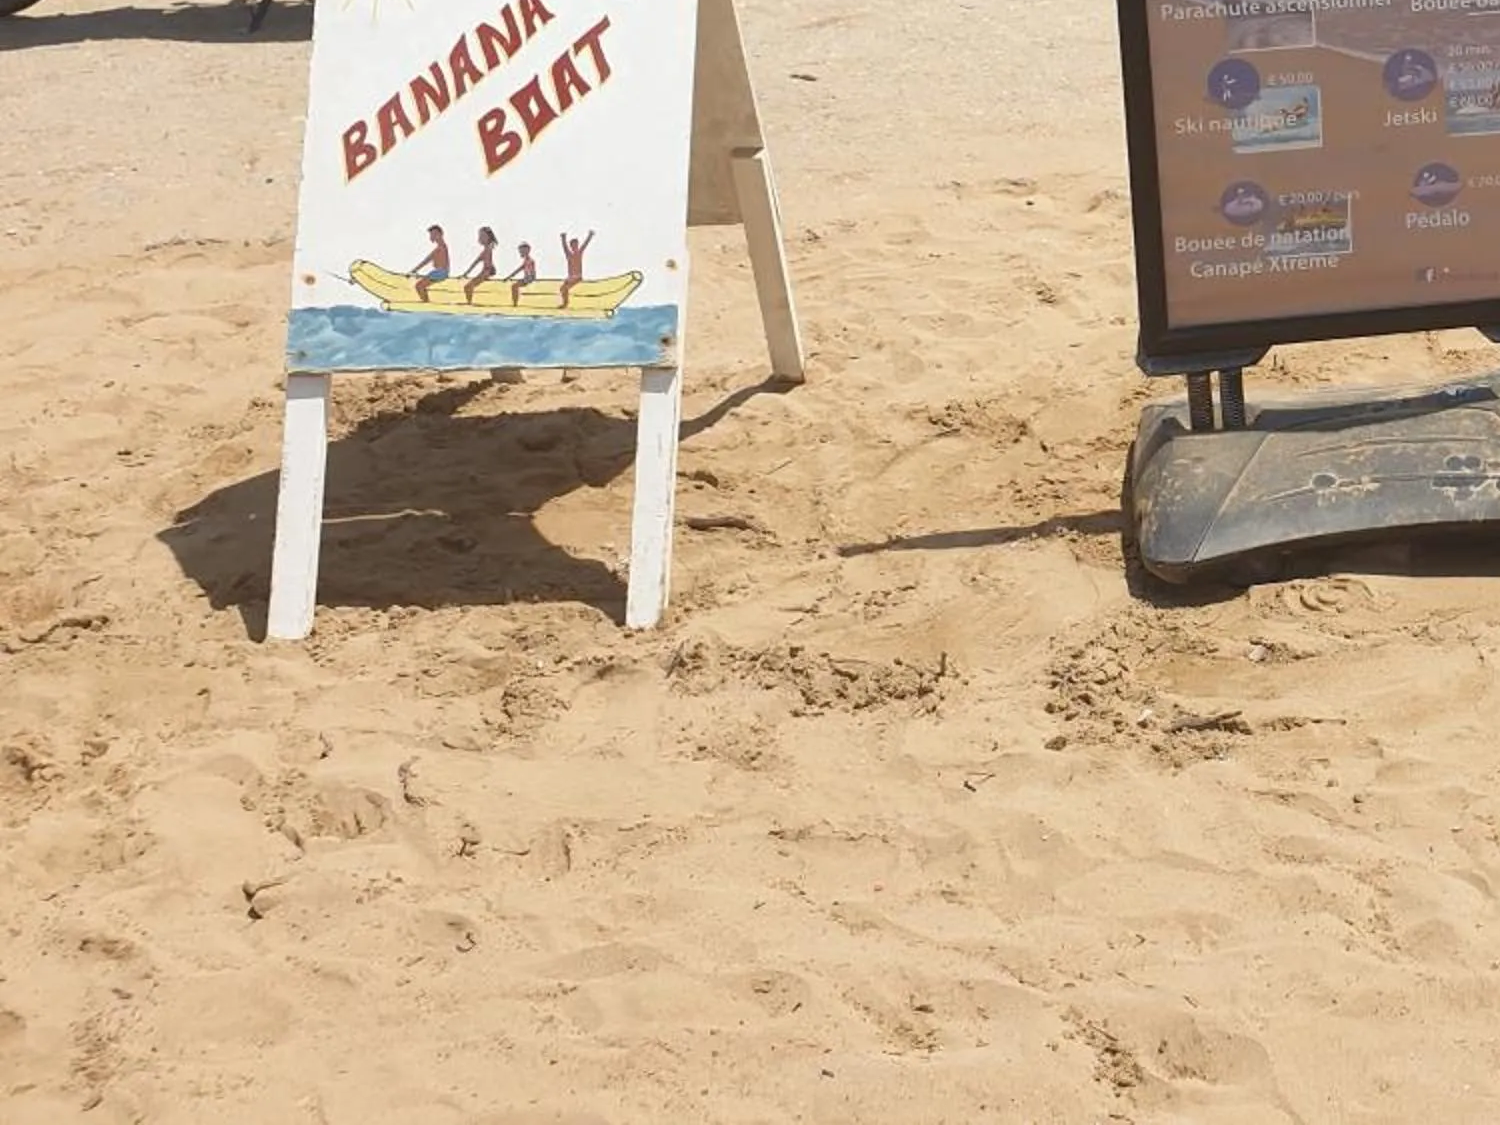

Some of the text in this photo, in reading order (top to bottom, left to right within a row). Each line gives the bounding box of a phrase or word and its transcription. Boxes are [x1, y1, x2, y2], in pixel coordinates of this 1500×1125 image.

[477, 15, 611, 176] BOAT
[1174, 115, 1203, 136] Ski
[1384, 107, 1438, 127] Jetski
[1241, 230, 1265, 249] de
